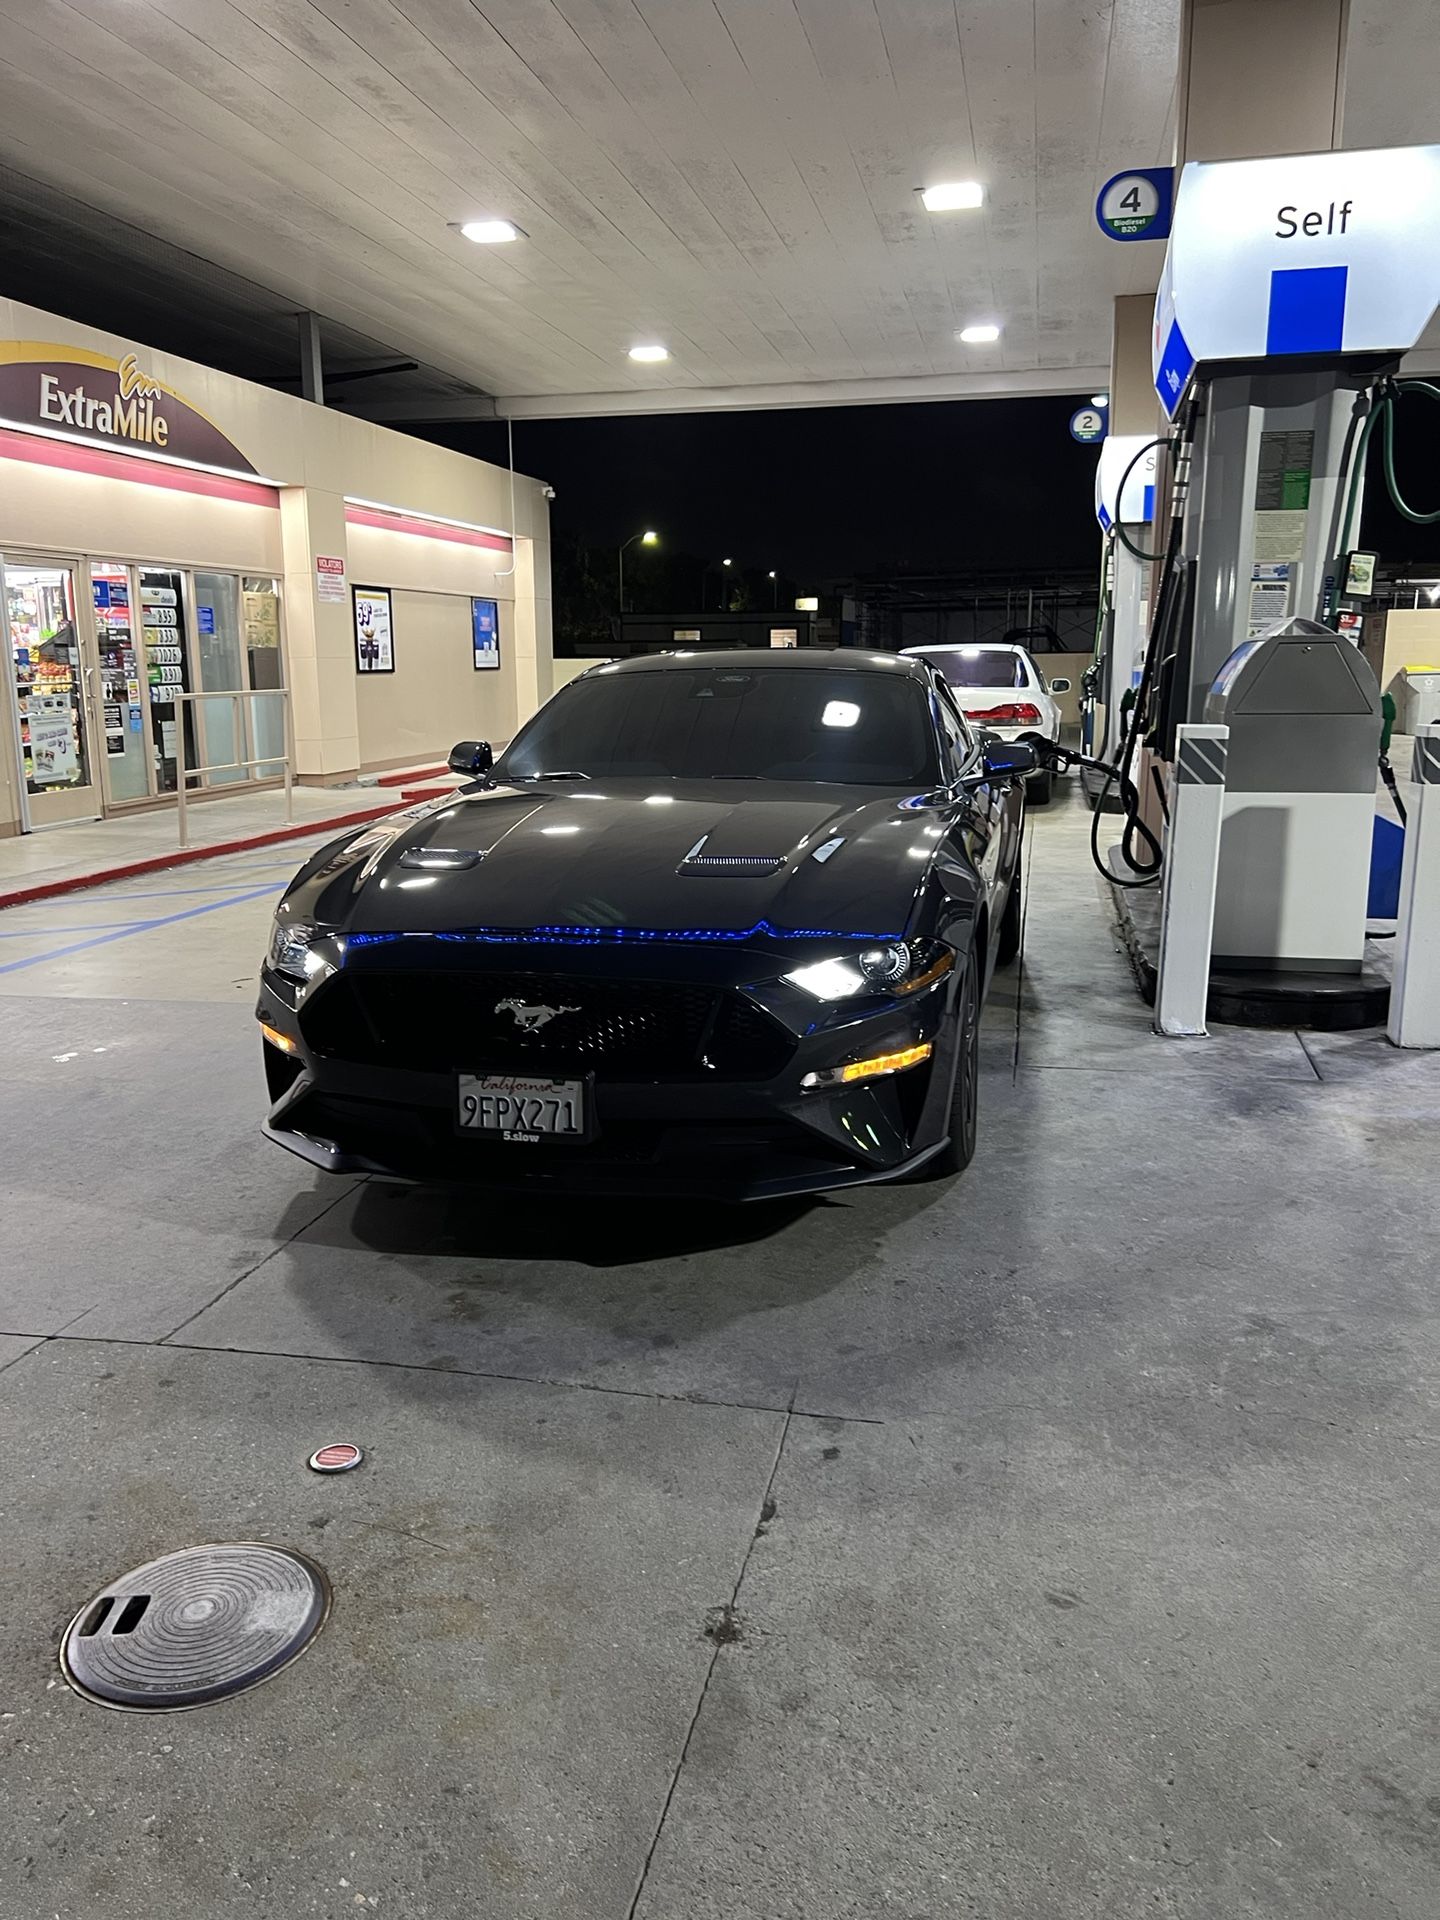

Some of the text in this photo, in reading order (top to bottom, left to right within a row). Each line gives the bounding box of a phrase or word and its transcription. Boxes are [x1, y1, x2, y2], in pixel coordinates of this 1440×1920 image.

[1119, 187, 1141, 212] 4
[1113, 218, 1146, 227] Biodiesel
[1275, 200, 1352, 239] Self
[39, 373, 168, 446] ExtraMile
[1083, 415, 1093, 429] 2
[481, 1076, 561, 1094] California
[464, 1095, 578, 1132] 9FPX271
[503, 1131, 539, 1142] 5.slow
